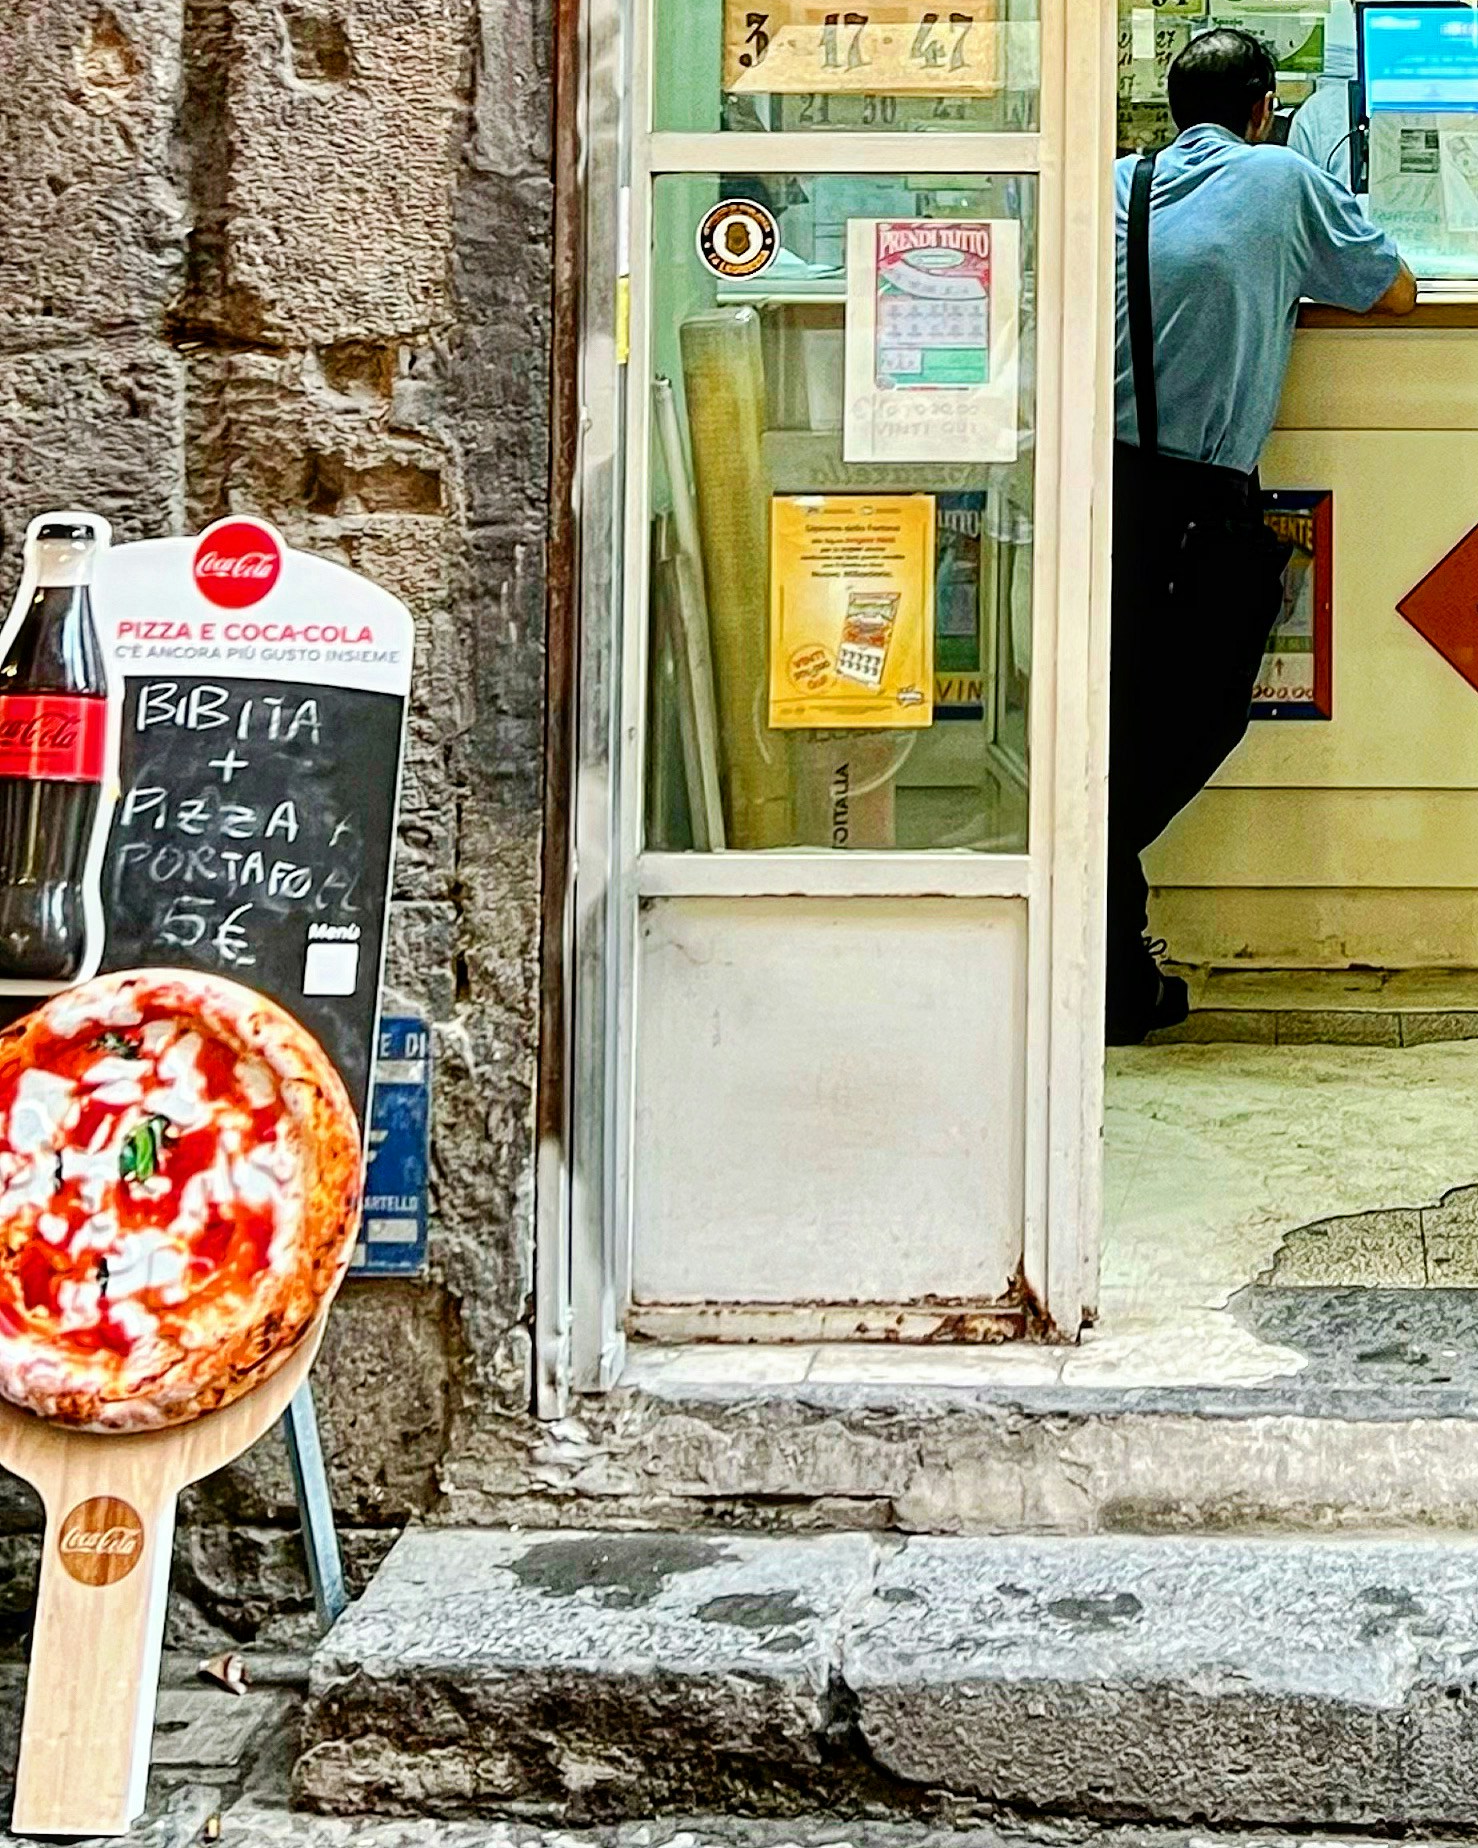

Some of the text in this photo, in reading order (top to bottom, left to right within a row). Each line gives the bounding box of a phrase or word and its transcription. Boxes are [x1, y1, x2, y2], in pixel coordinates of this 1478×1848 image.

[817, 12, 873, 73] 17
[878, 229, 990, 260] PRENDI TUTTO
[194, 550, 280, 581] Coca-Cola
[116, 621, 374, 643] PIZZA E COCA-COLA
[146, 645, 222, 660] ANCORA
[260, 647, 322, 663] GUSTO
[326, 649, 401, 665] INSIEME
[136, 682, 324, 745] BIBITA
[119, 786, 300, 844] PIZZA
[362, 1195, 419, 1212] ARTELLO
[60, 1525, 142, 1556] Coca-Cola
